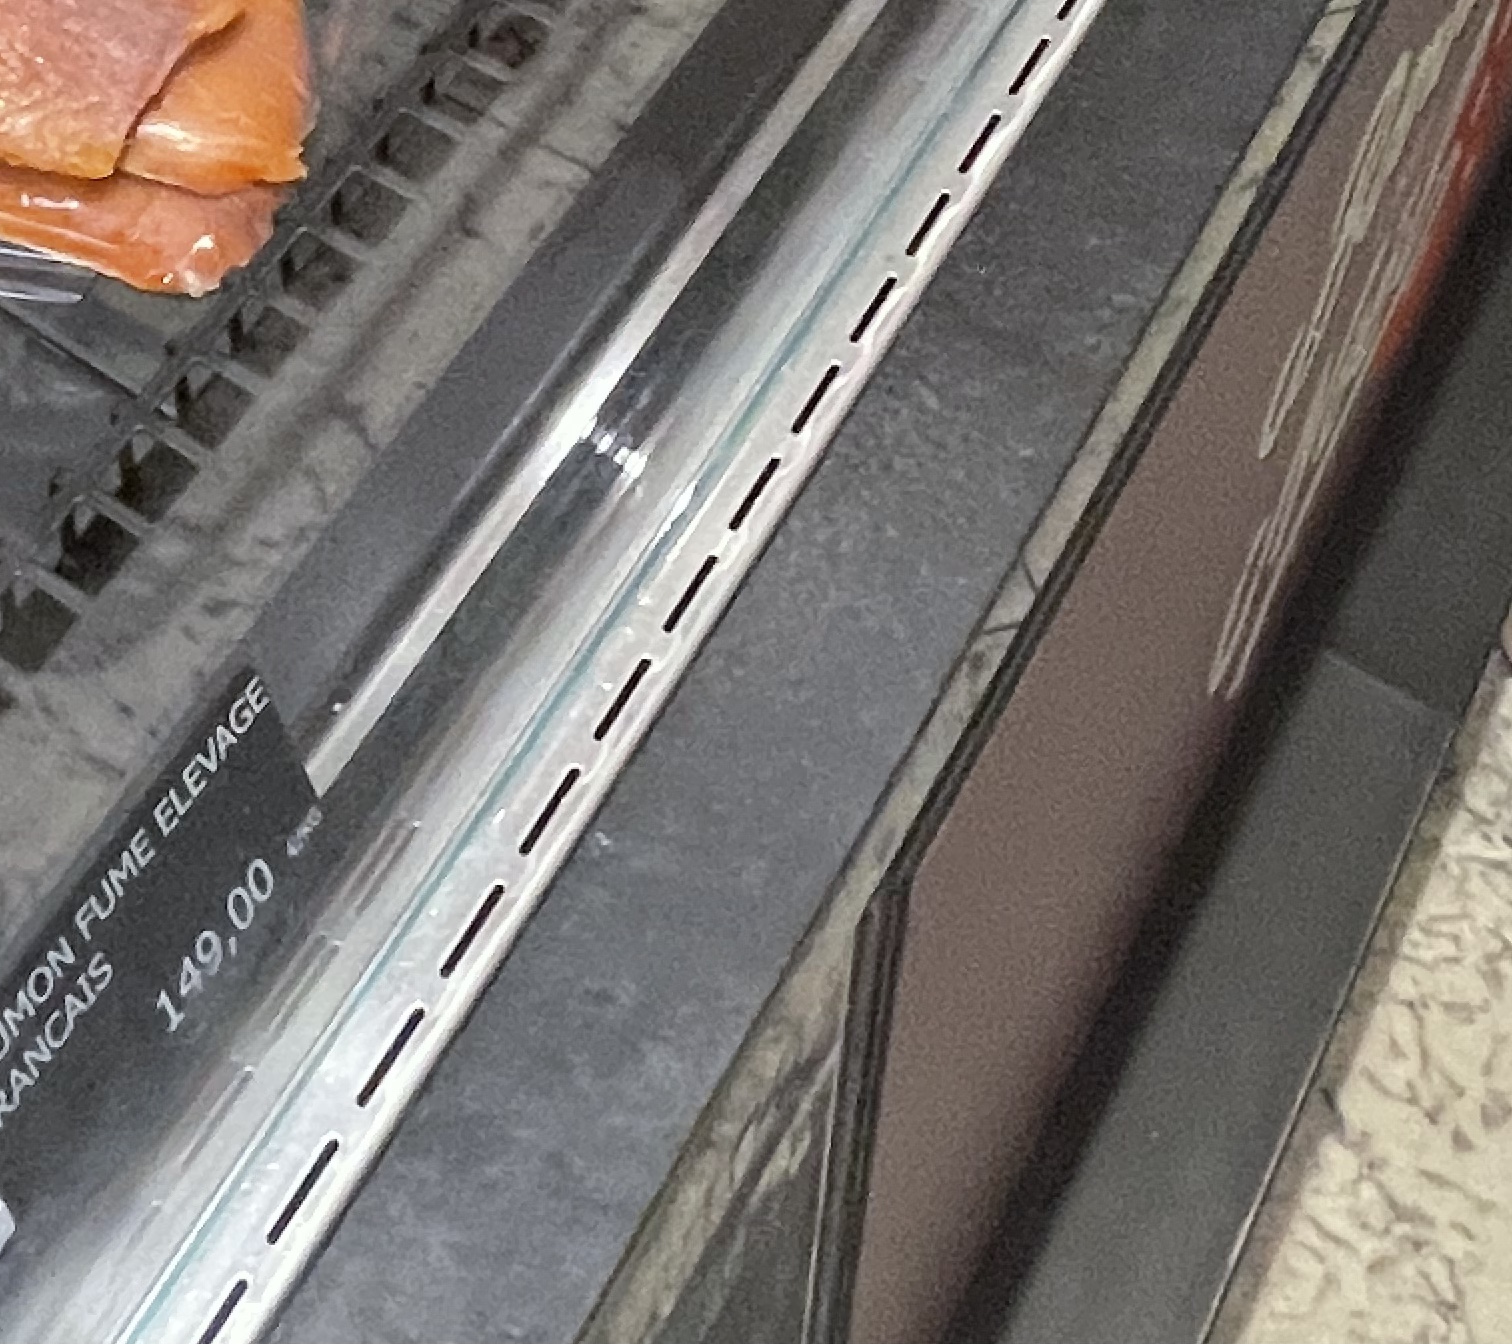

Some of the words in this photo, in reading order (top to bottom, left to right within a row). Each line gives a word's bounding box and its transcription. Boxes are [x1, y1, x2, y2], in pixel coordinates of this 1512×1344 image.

[73, 826, 159, 942] FUME
[152, 674, 274, 837] ELEVAGE
[152, 857, 276, 1035] 149,00
